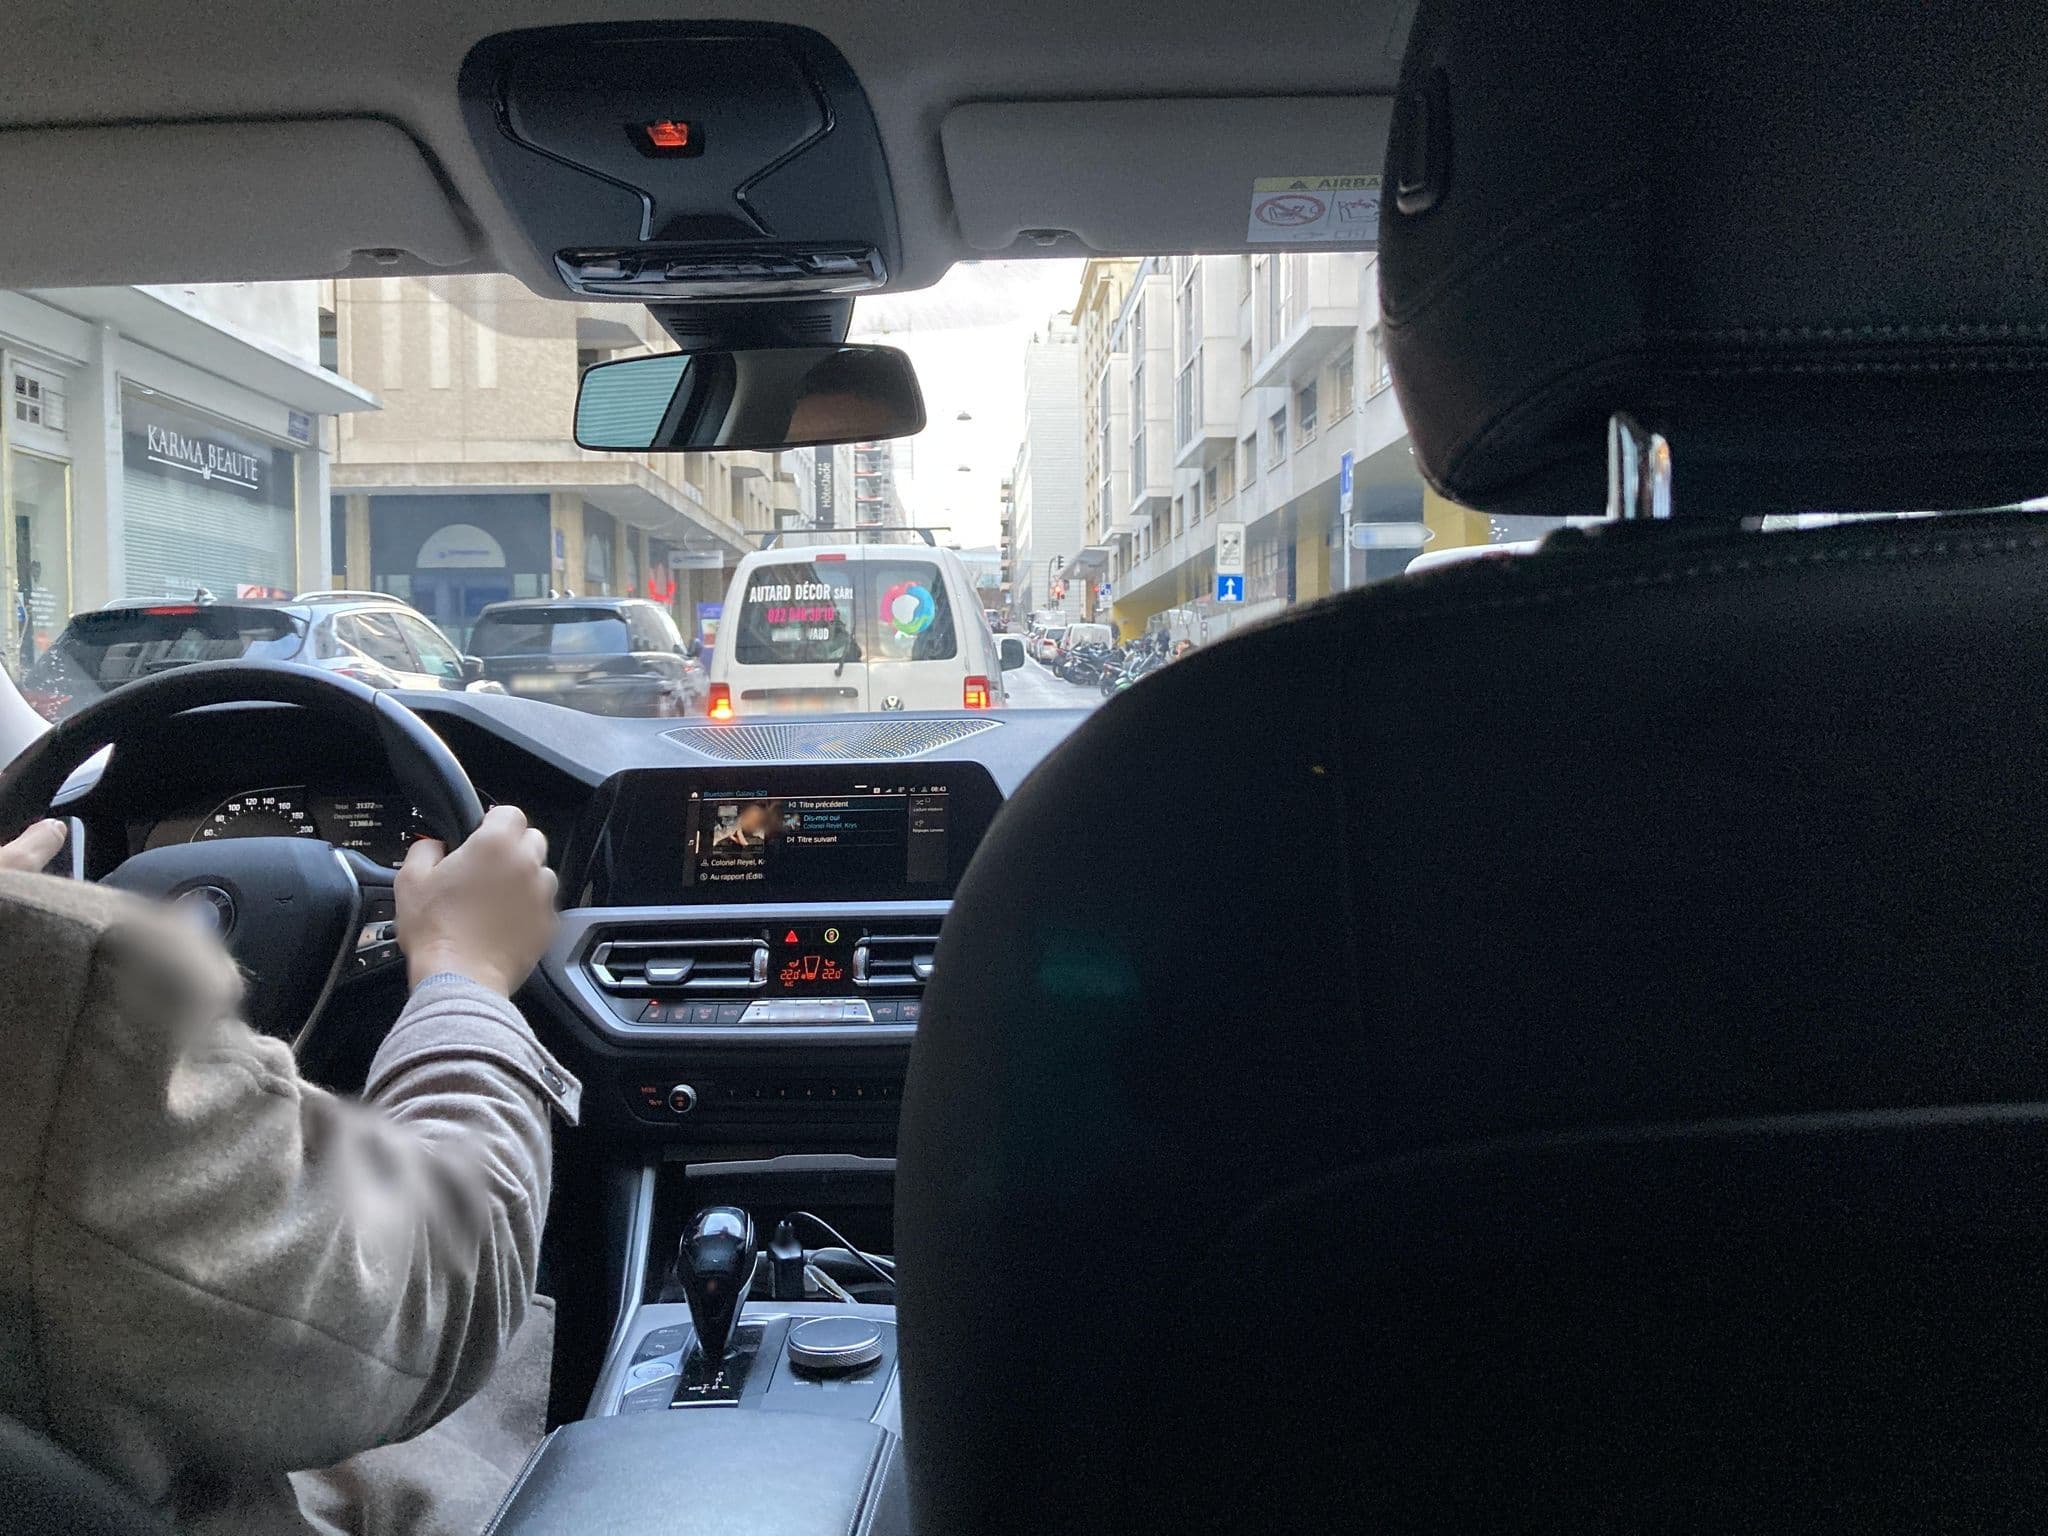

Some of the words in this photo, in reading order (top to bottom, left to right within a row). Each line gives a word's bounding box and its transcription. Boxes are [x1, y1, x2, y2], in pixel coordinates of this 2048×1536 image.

[1317, 177, 1380, 190] AIRBA
[147, 424, 204, 466] KARMA
[749, 583, 791, 603] AUTARD
[795, 581, 831, 600] DÉCOR
[279, 802, 291, 810] 160
[815, 800, 849, 809] précédent
[411, 806, 418, 816] 2
[803, 814, 828, 822] Dis-moi
[204, 829, 214, 837] 60
[400, 831, 405, 841] 1
[720, 873, 744, 881] rapport
